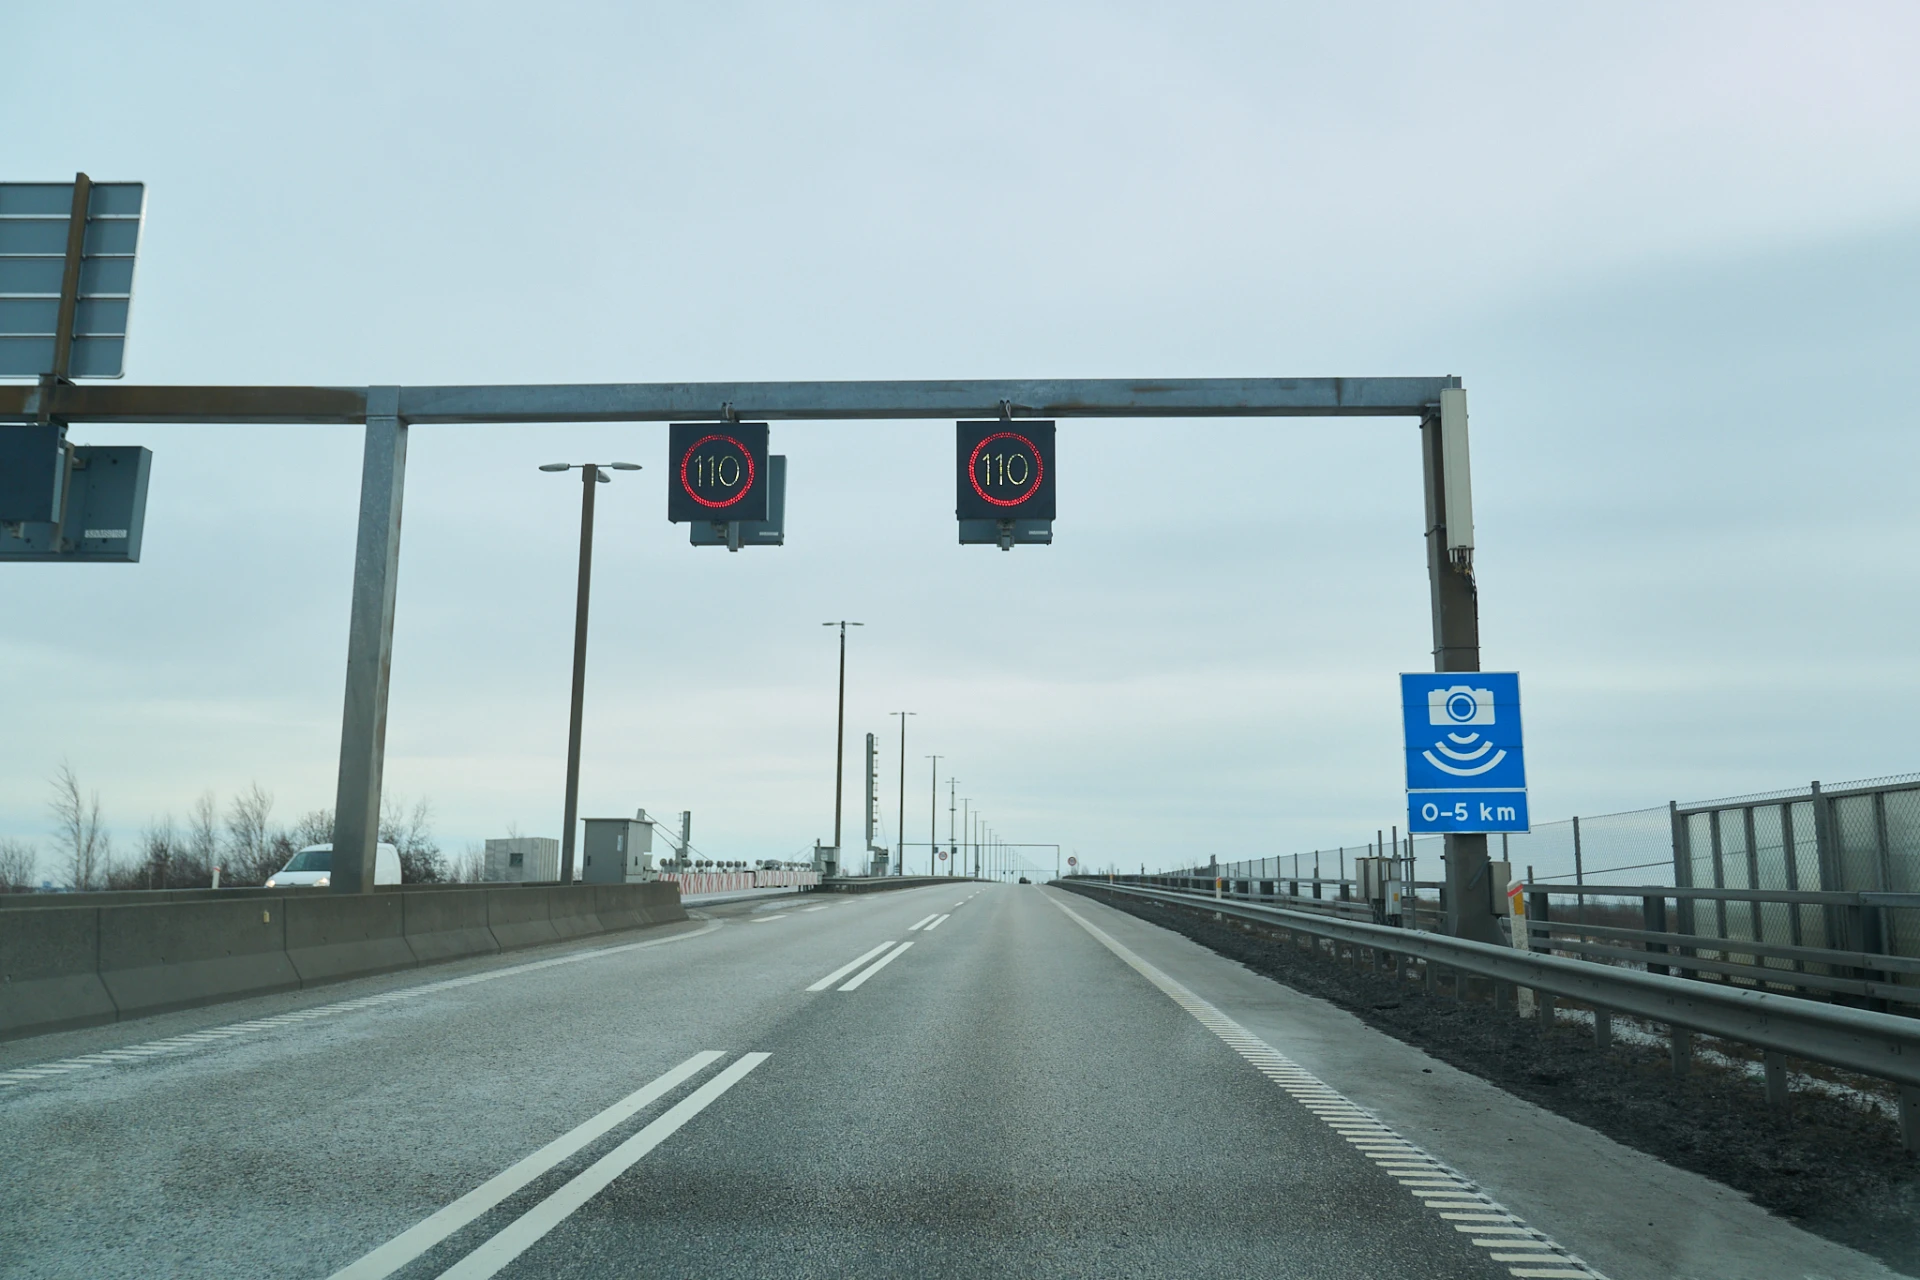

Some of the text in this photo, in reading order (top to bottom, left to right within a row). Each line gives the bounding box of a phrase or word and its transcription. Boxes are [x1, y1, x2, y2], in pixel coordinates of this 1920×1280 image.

[694, 455, 740, 487] 110
[982, 453, 1028, 486] 110
[1479, 802, 1516, 821] km
